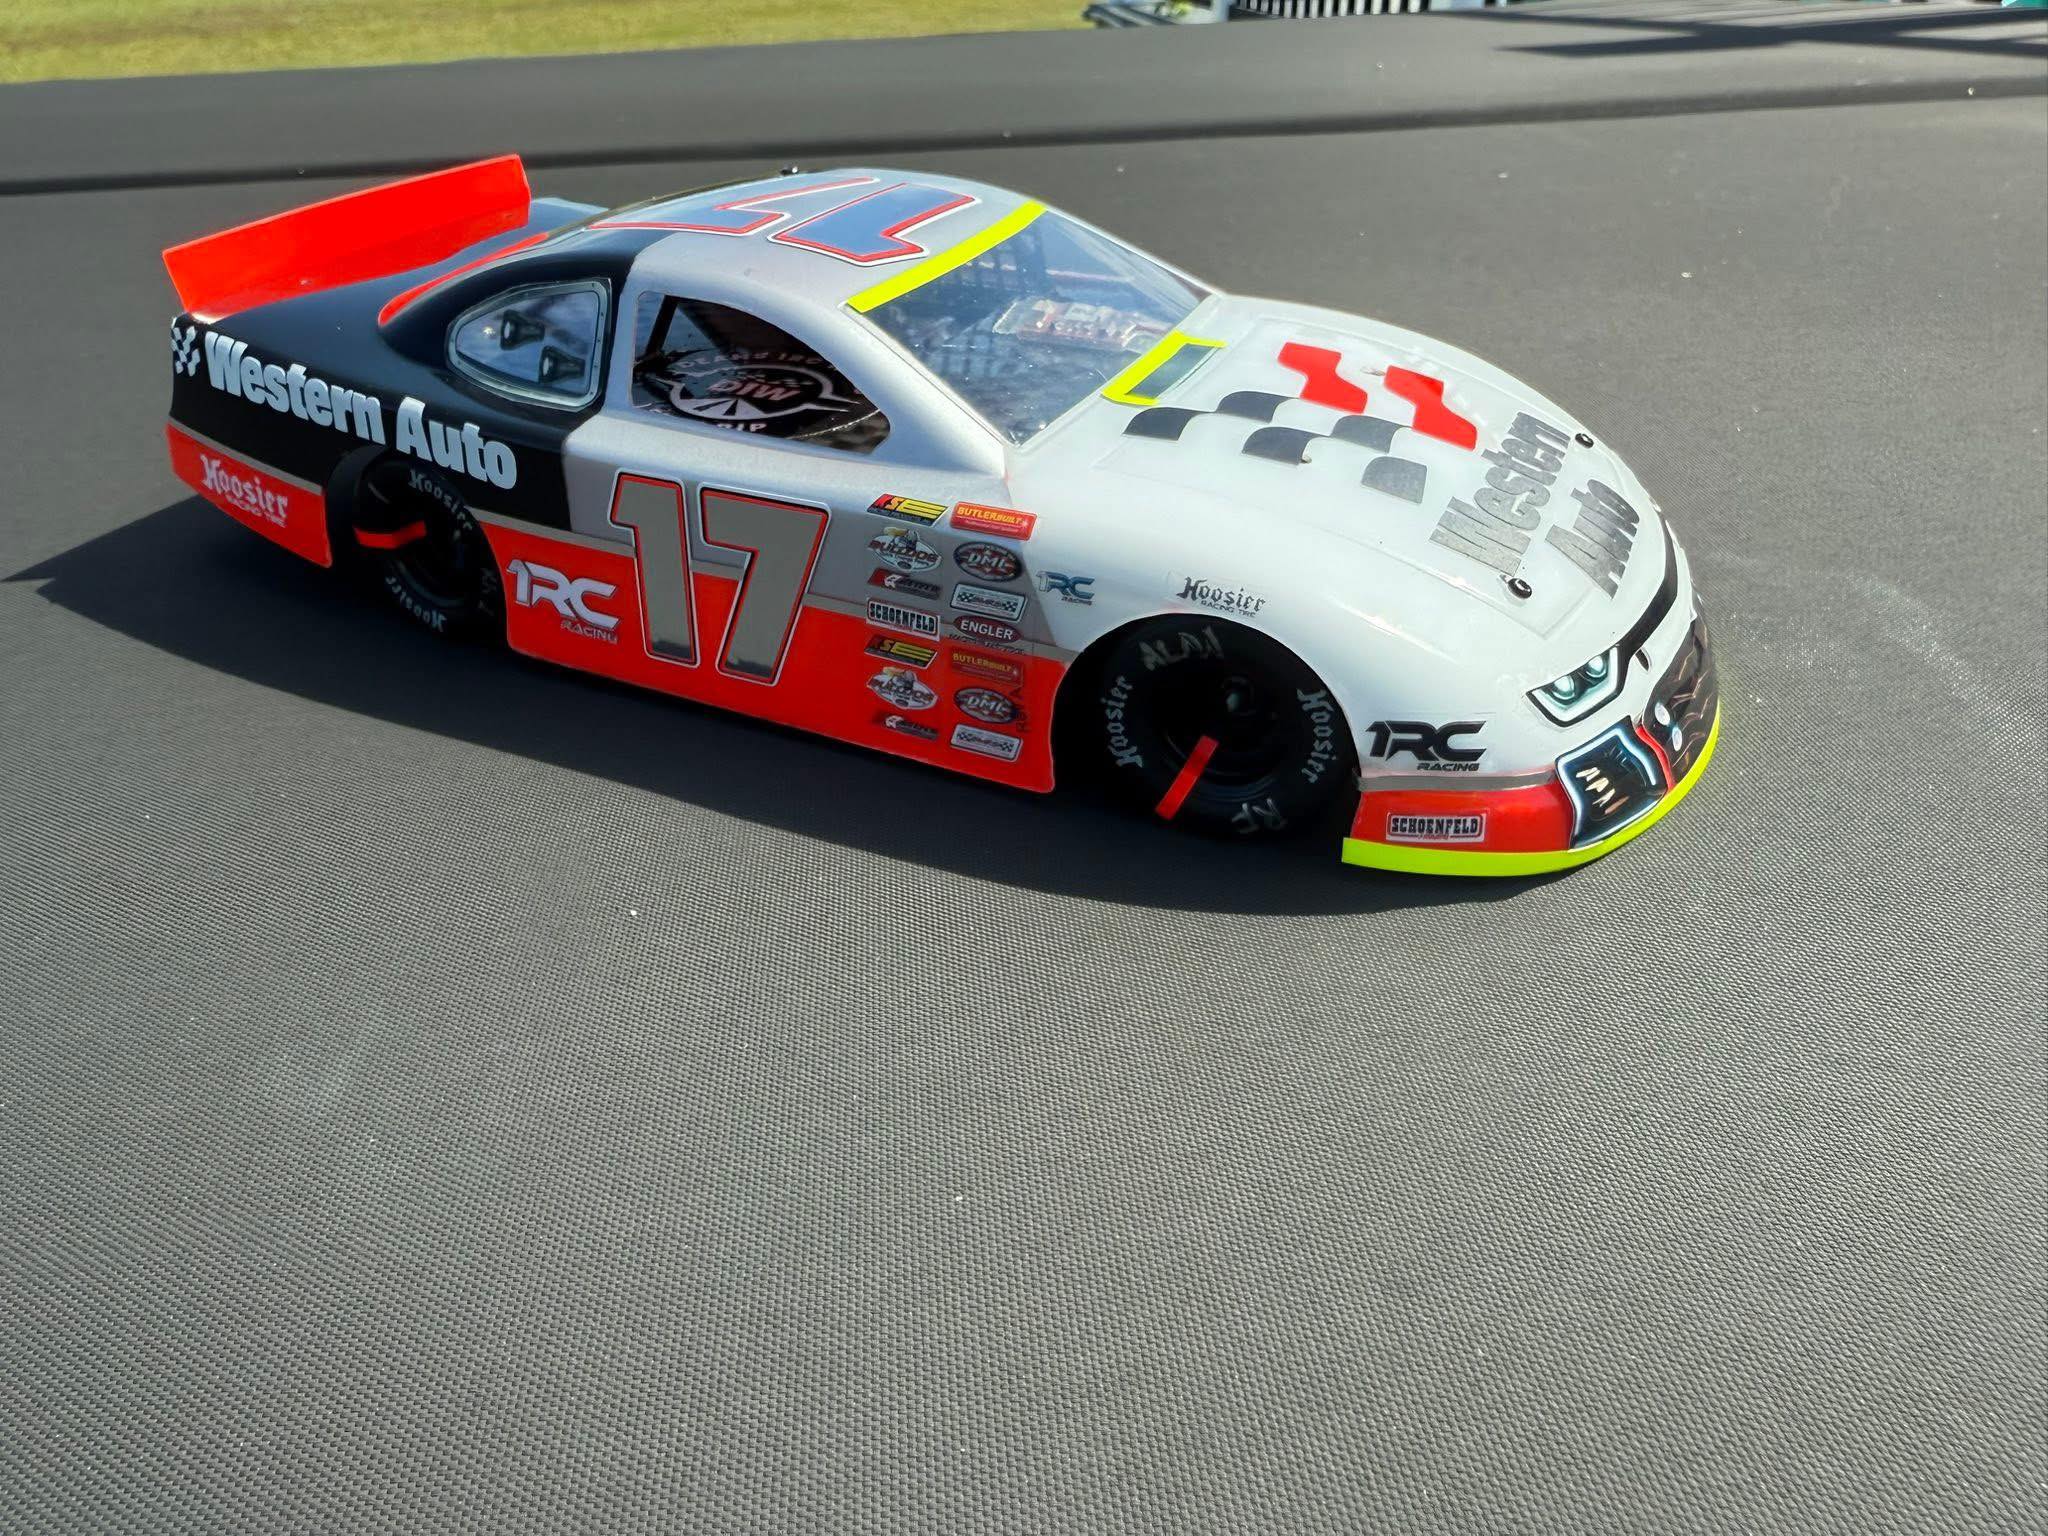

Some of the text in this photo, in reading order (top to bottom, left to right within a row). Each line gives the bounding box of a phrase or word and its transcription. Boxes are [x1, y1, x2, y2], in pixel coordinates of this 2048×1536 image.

[203, 331, 518, 490] Western Auto
[200, 454, 289, 518] Hoosier
[1429, 411, 1640, 601] Western Auto
[506, 558, 620, 631] 1RC
[607, 467, 832, 686] 17
[1175, 576, 1267, 613] Hoosier
[869, 601, 936, 632] SCHOENFELD
[1200, 599, 1236, 613] RACING
[560, 618, 619, 645] RACING
[960, 620, 1014, 641] ENGLER
[1100, 675, 1144, 769] Hoosier
[1297, 688, 1338, 784] Hoosier
[1365, 720, 1488, 762] 1RC
[1416, 762, 1480, 772] RACING
[1391, 817, 1479, 834] SCHOENFELD
